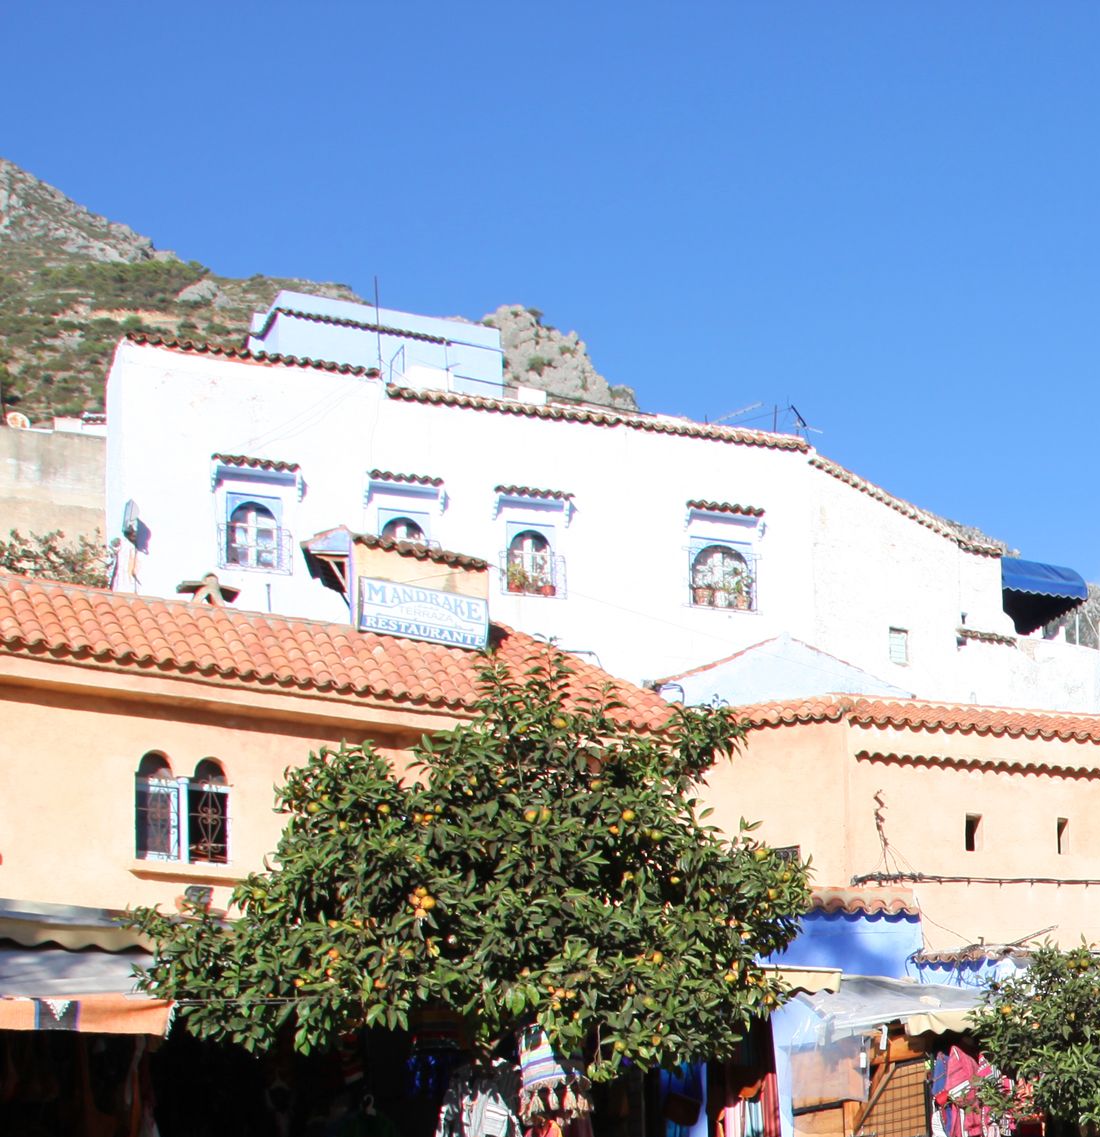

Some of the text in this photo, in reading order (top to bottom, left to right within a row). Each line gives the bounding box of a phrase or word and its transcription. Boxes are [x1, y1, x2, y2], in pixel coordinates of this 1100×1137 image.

[367, 582, 481, 621] MANDRAKE
[400, 606, 454, 623] TERRAZA
[366, 616, 484, 645] RESTAURANTE
